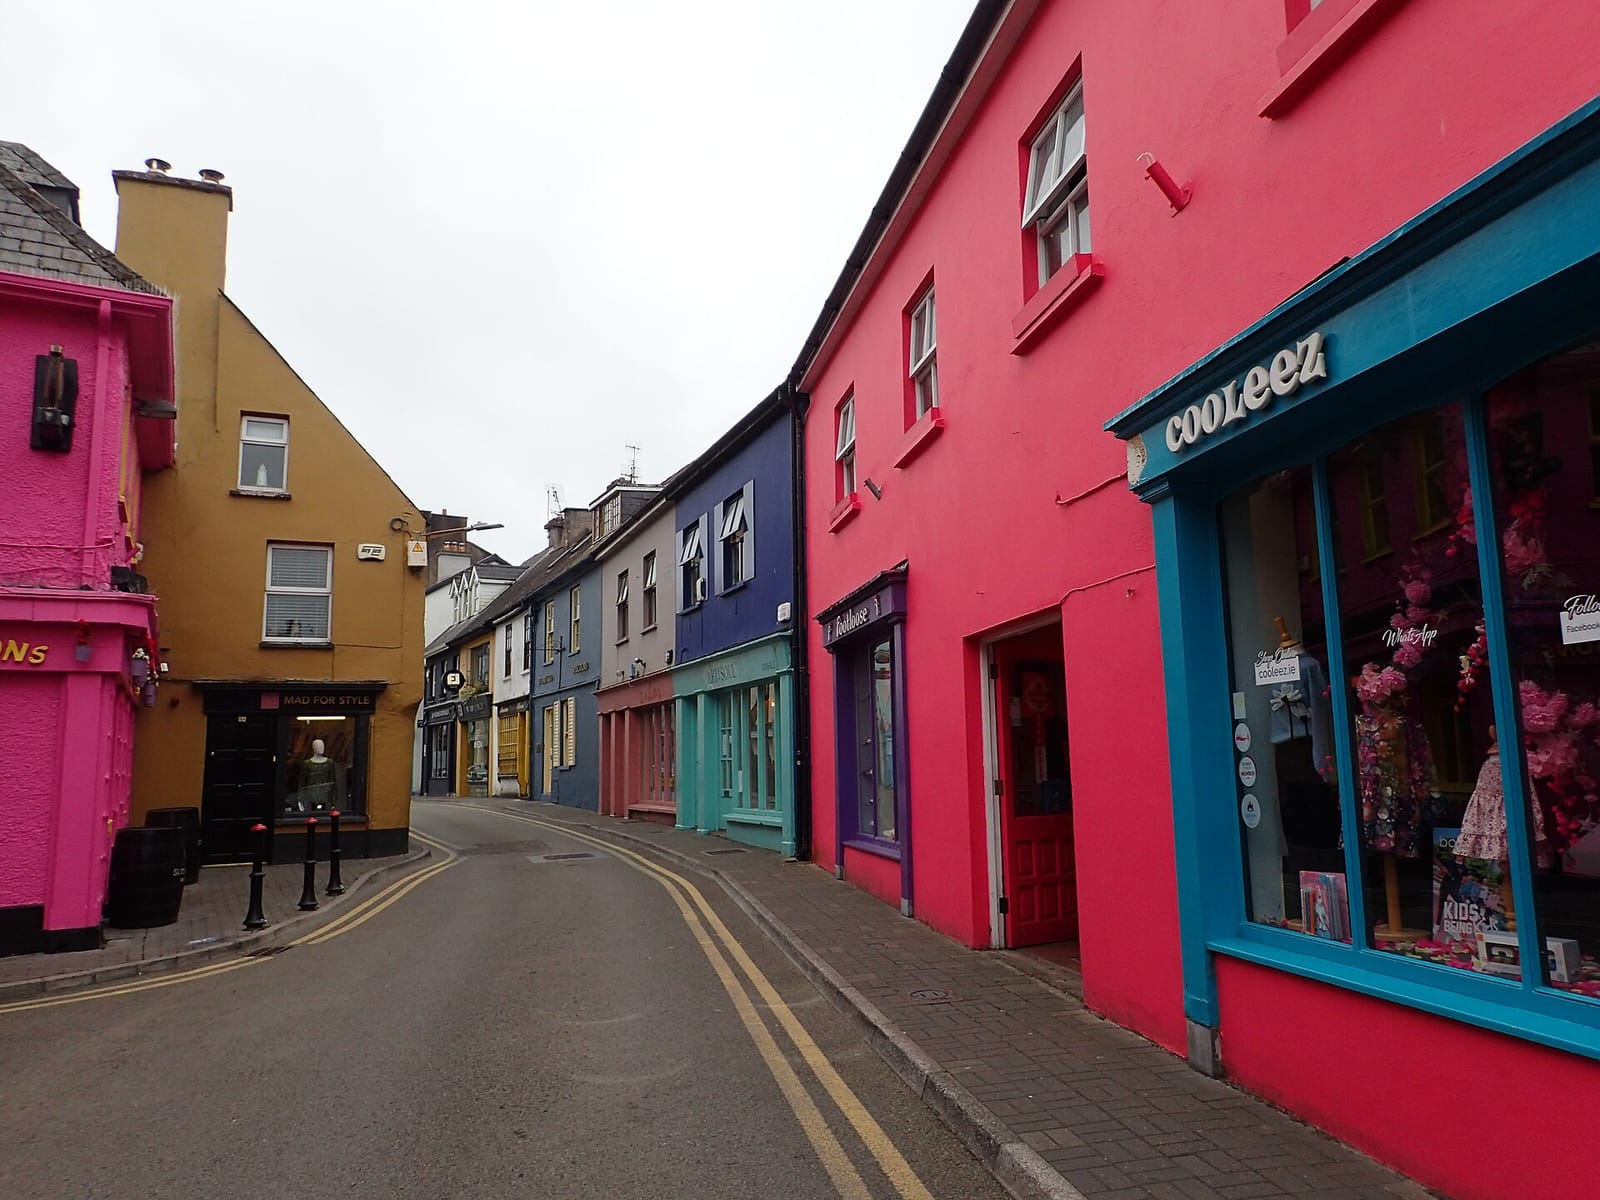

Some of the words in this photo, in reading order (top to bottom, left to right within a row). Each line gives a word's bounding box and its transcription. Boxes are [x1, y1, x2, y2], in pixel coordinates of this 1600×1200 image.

[1563, 595, 1600, 620] Follo
[0, 640, 49, 664] NS
[284, 696, 310, 704] MAD
[314, 696, 336, 704] FOR
[339, 696, 370, 705] STYLE
